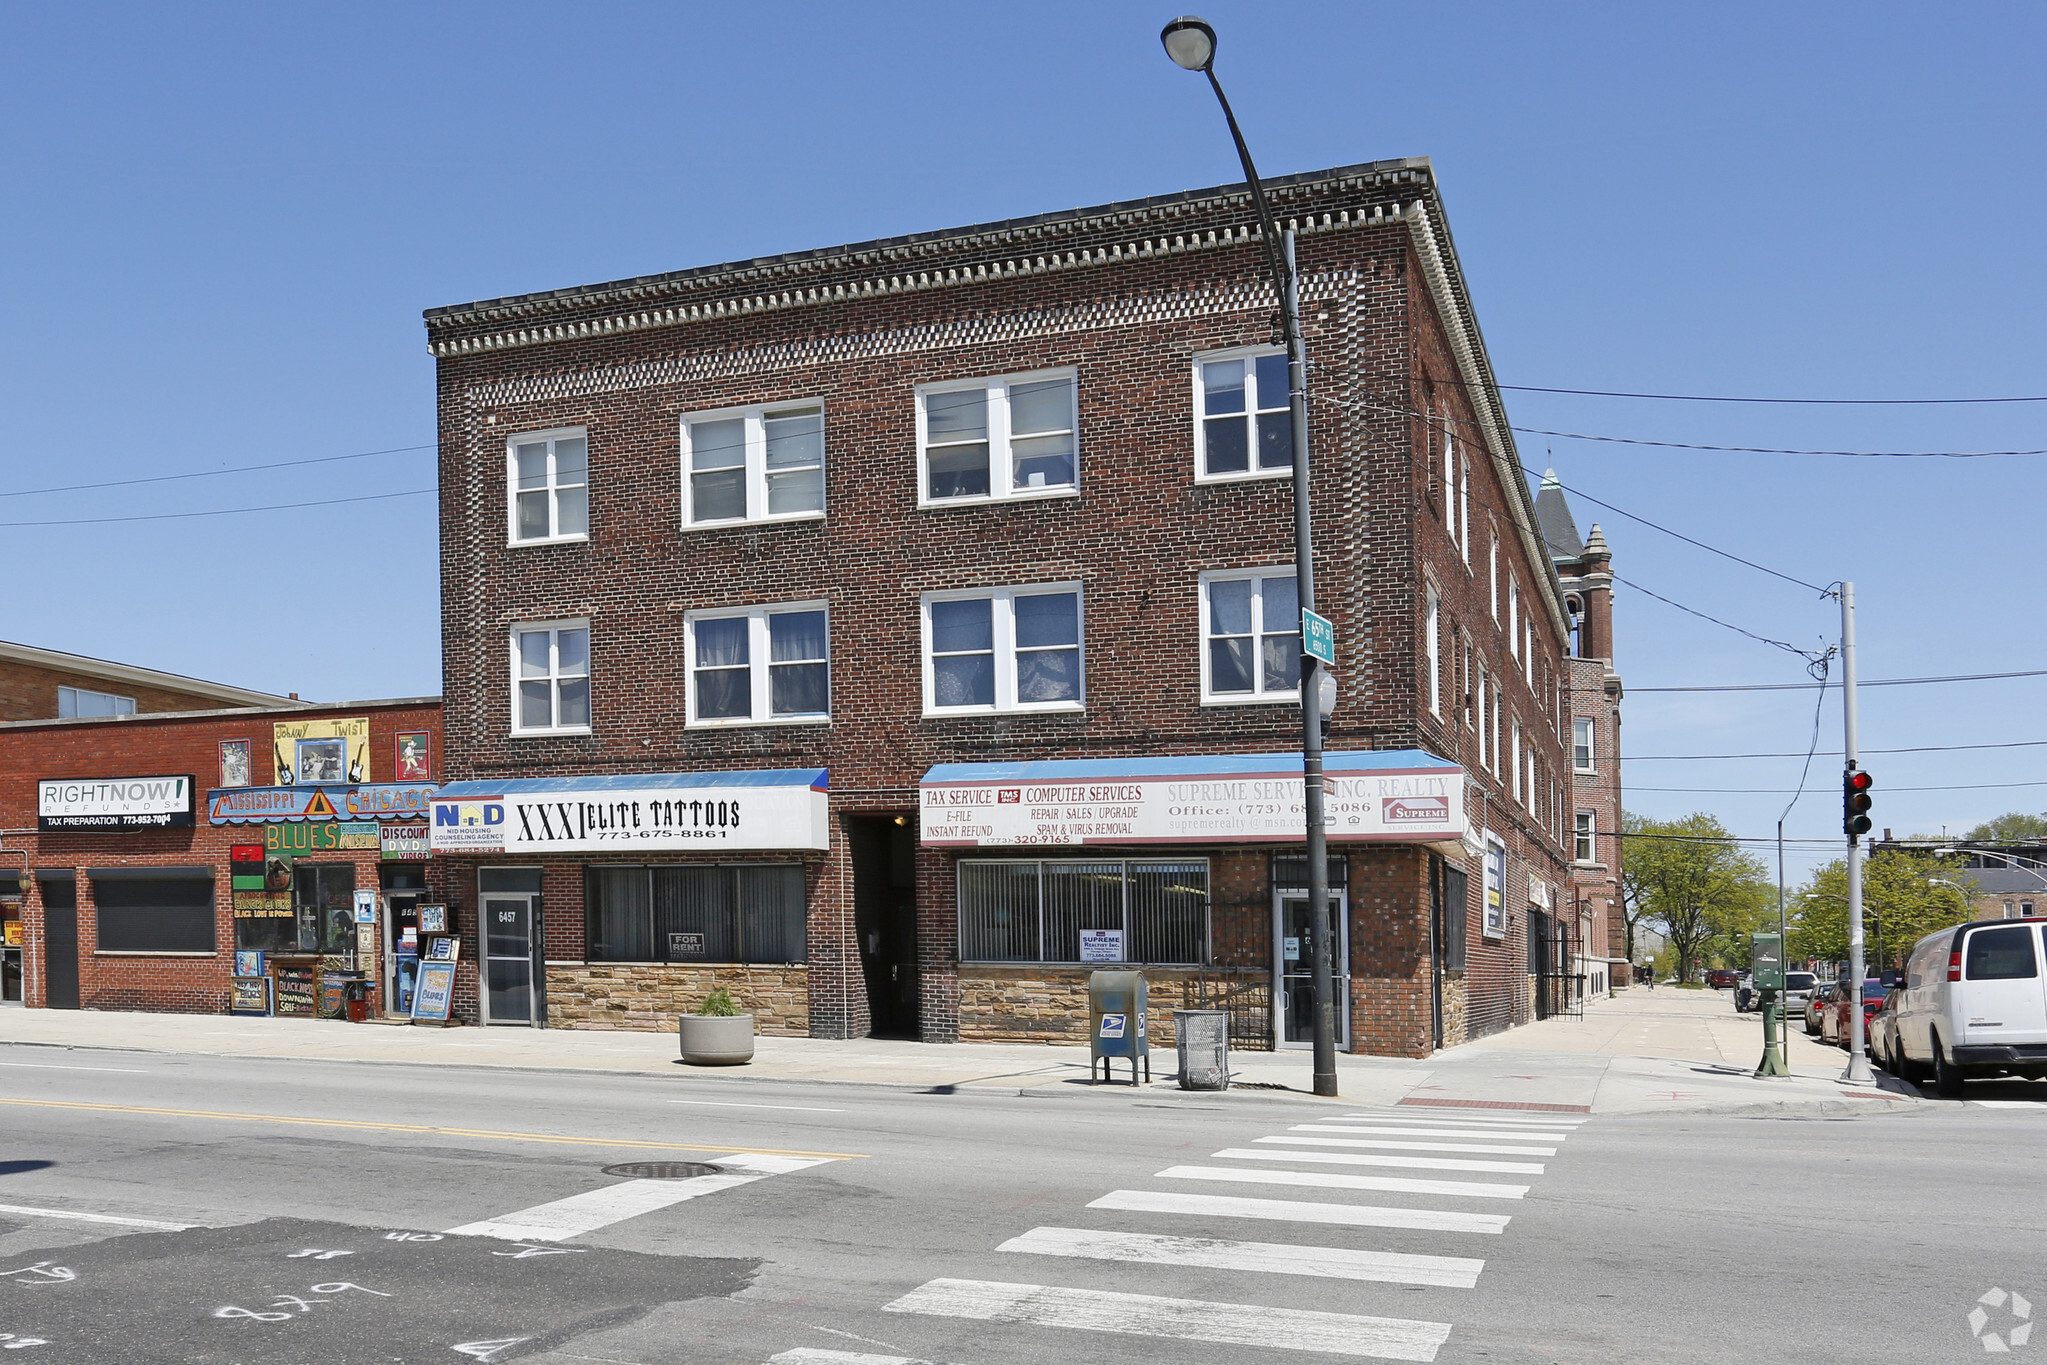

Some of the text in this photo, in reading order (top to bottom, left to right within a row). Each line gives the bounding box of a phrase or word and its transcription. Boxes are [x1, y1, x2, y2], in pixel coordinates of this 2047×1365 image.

[1000, 790, 1019, 798] TMS
[1026, 785, 1143, 803] COMPUTER SERVICES
[1168, 782, 1248, 803] SUPREME
[1335, 779, 1371, 798] INC.
[1377, 777, 1448, 797] REALTY
[926, 789, 993, 805] TAX SERVICE
[45, 800, 171, 813] REFUNDS
[1030, 808, 1059, 820] REPAIR
[1066, 807, 1092, 820] SALES
[1099, 806, 1139, 819] UPGRADE
[1168, 804, 1230, 816] Office:
[1238, 803, 1281, 816] (773)
[1396, 808, 1447, 818] SUPREME
[47, 817, 62, 826] TAX
[63, 816, 118, 826] PREPARATION
[517, 802, 587, 841] XXXI
[650, 798, 740, 830] TATTOOS
[1168, 815, 1307, 833] supremerealty @ msn.co
[382, 827, 430, 839] DISCOUNT
[597, 829, 728, 841] 773-675-8861
[927, 825, 993, 838] INSTANT REFUND
[1036, 823, 1133, 836] SPAM & VIRUS REMOVAL
[266, 823, 338, 850] BLUES
[234, 900, 291, 910] BLACK BOOKS
[499, 911, 516, 922] 6457
[675, 936, 698, 944] FOR
[672, 943, 702, 951] RENT
